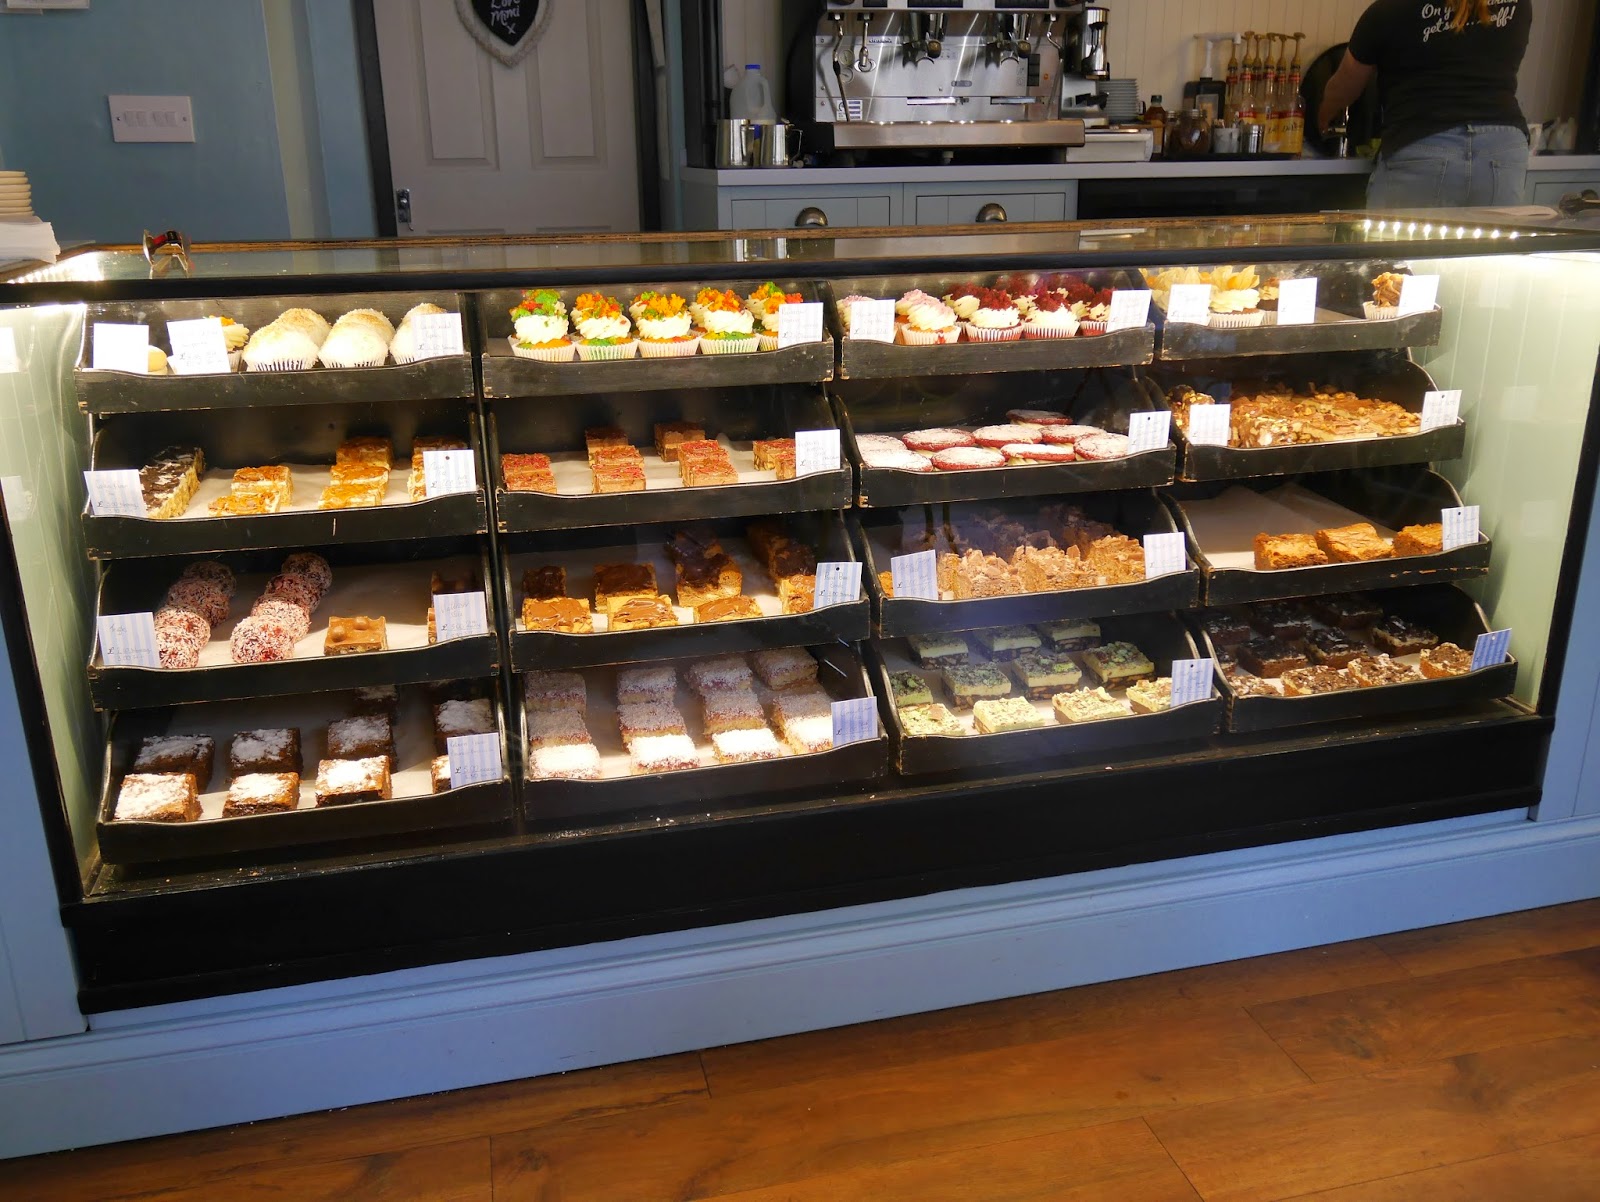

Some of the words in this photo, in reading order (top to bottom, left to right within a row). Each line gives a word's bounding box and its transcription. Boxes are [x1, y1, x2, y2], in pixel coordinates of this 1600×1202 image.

[1421, 3, 1441, 19] On
[1423, 17, 1443, 42] get
[1490, 5, 1516, 28] off!
